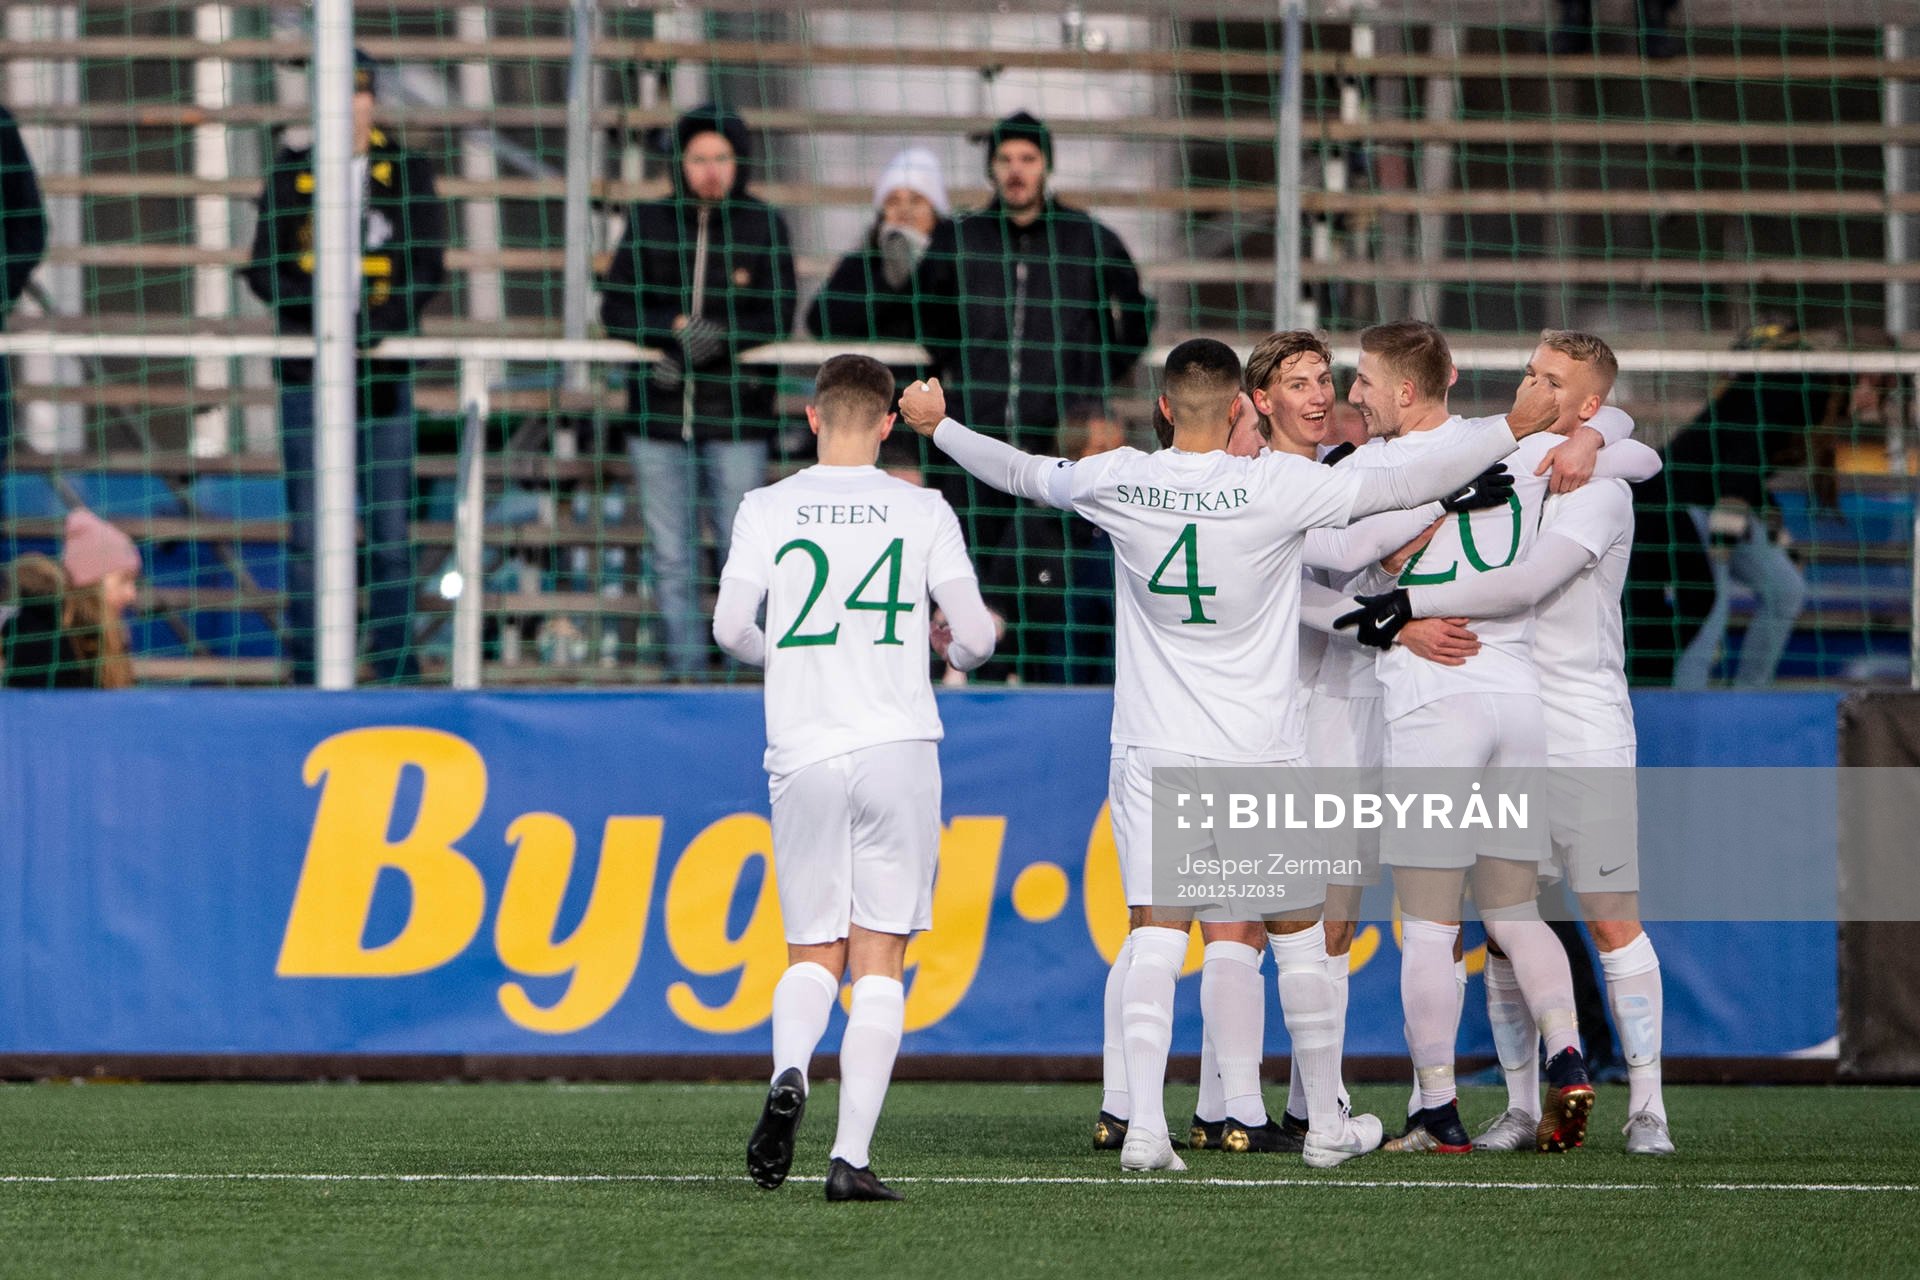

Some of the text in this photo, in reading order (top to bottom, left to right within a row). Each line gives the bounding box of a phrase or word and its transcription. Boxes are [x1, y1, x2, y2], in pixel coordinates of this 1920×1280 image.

[796, 504, 888, 525] STEEN
[1116, 484, 1249, 512] SABETKAR
[774, 538, 915, 648] 24
[1148, 523, 1217, 624] 4
